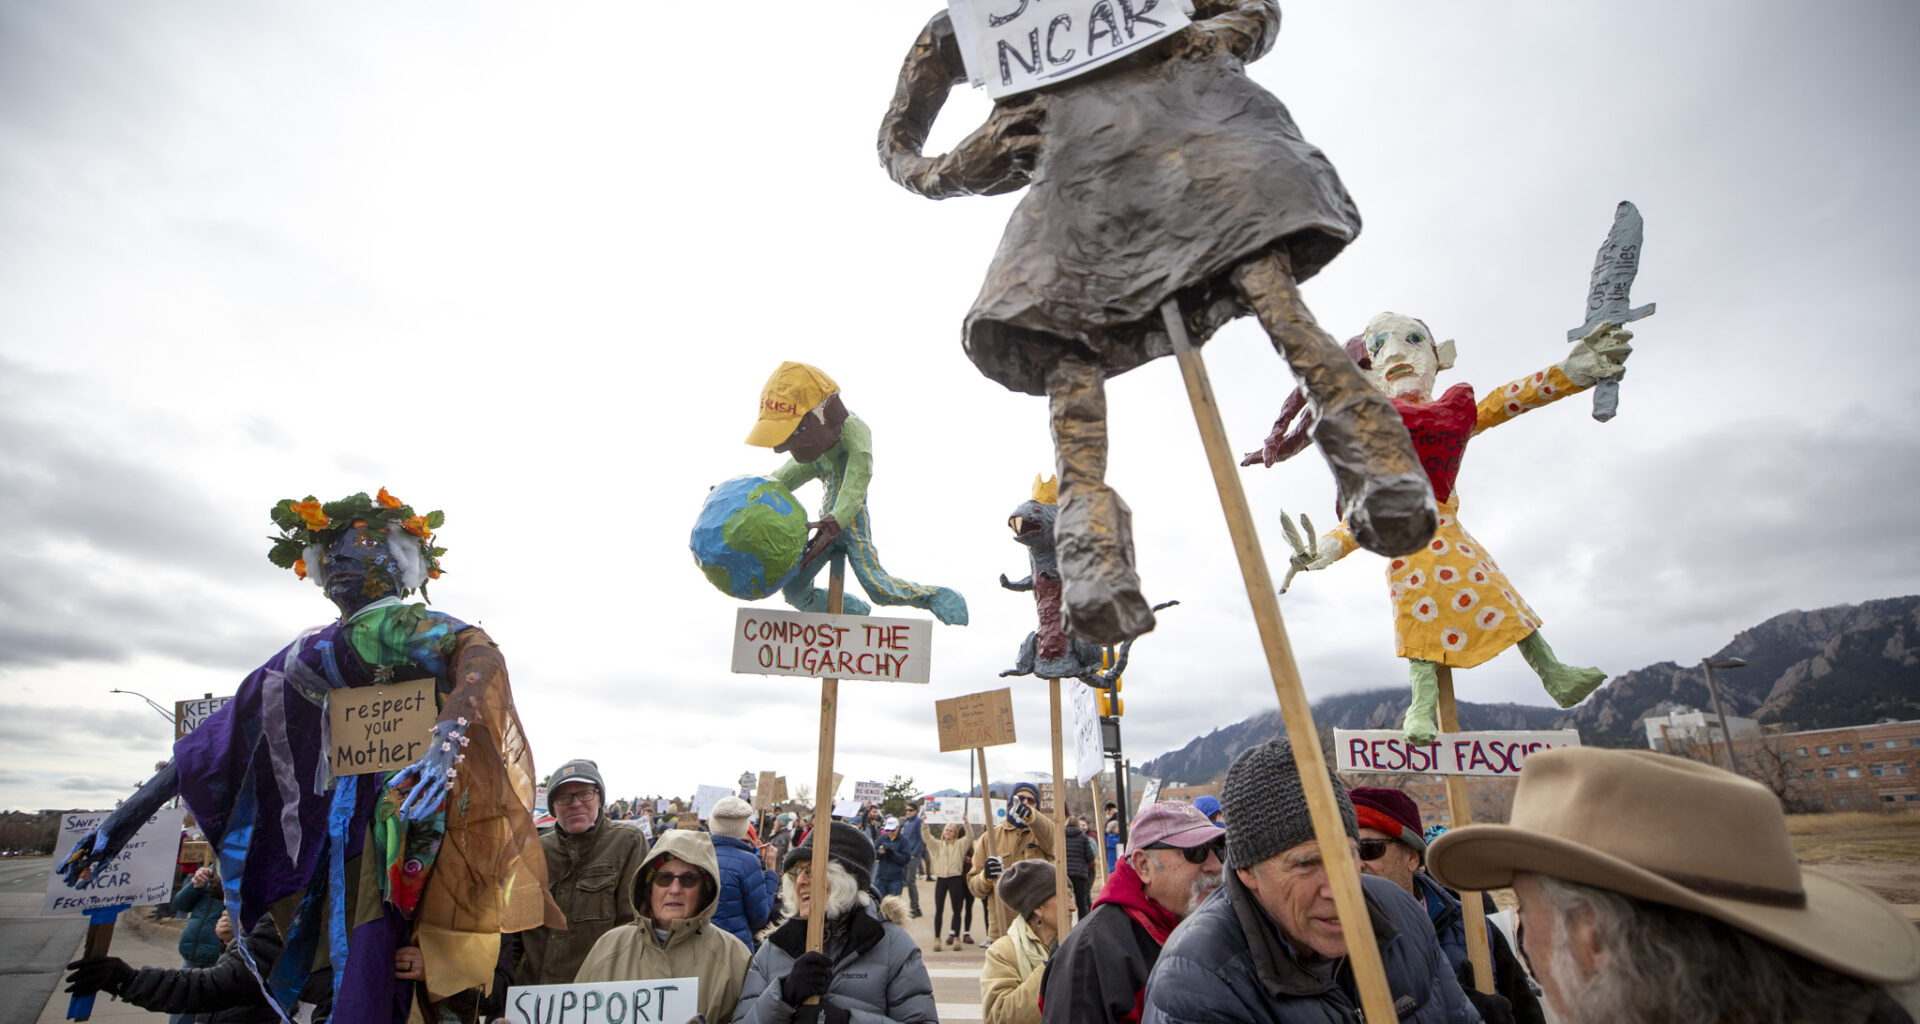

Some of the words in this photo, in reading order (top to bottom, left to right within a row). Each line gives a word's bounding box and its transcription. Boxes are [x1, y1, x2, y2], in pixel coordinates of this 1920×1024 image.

[997, 0, 1167, 86] NCAR
[744, 617, 850, 649] COMPOST
[861, 623, 910, 652] THE
[758, 644, 909, 679] OLIGARCHY
[345, 690, 426, 722] respect
[364, 718, 403, 740] your
[337, 738, 421, 768] Mother
[1349, 738, 1442, 771] RESIST
[515, 984, 679, 1024] SUPPORT
